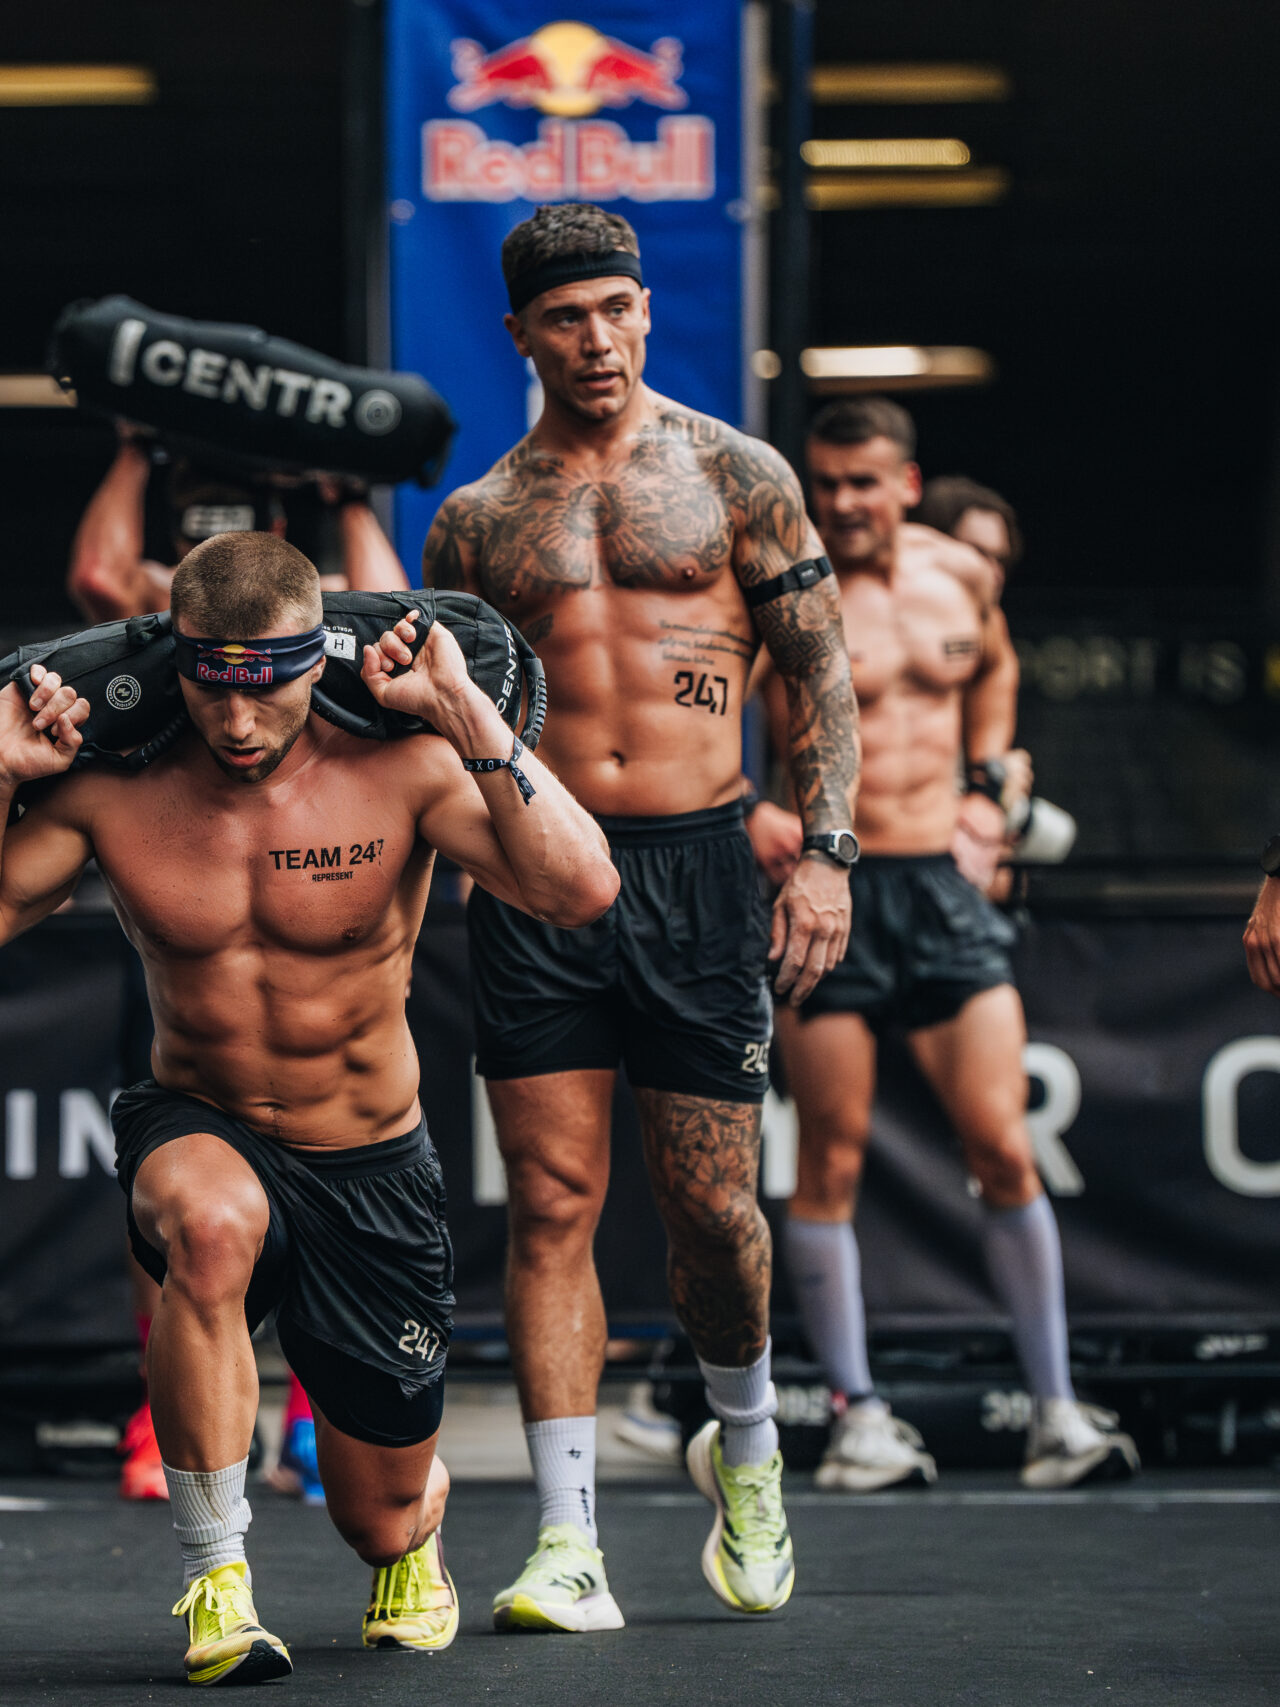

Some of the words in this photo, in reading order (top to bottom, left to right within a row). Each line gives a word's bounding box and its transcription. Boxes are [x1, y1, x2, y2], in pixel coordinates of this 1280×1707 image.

[422, 116, 566, 203] Red
[568, 114, 716, 202] Bull
[142, 339, 353, 429] CENTR
[197, 662, 234, 683] Red
[235, 664, 274, 685] Bull
[673, 670, 729, 716] 247
[268, 846, 342, 870] TEAM
[348, 838, 385, 867] 247
[311, 871, 354, 882] REPRESENT
[398, 1319, 441, 1363] 247
